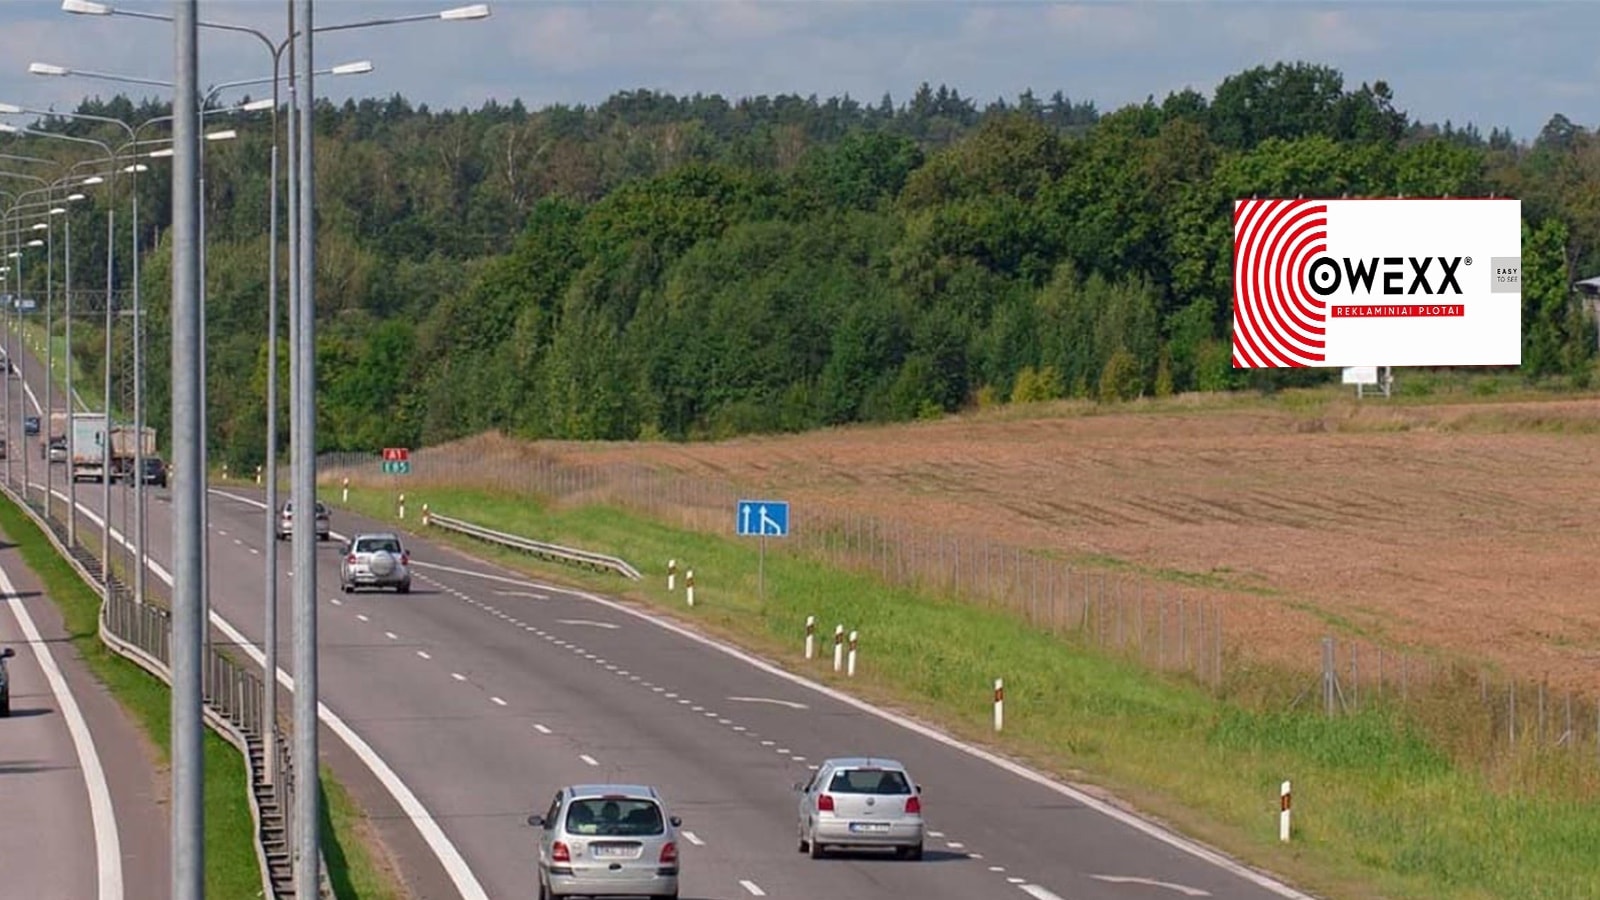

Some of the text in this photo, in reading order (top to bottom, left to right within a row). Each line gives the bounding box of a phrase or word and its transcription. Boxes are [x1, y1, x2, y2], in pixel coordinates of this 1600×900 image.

[1496, 275, 1518, 283] TO SEE
[1337, 306, 1460, 316] REKLAMINIAI PLOTAI
